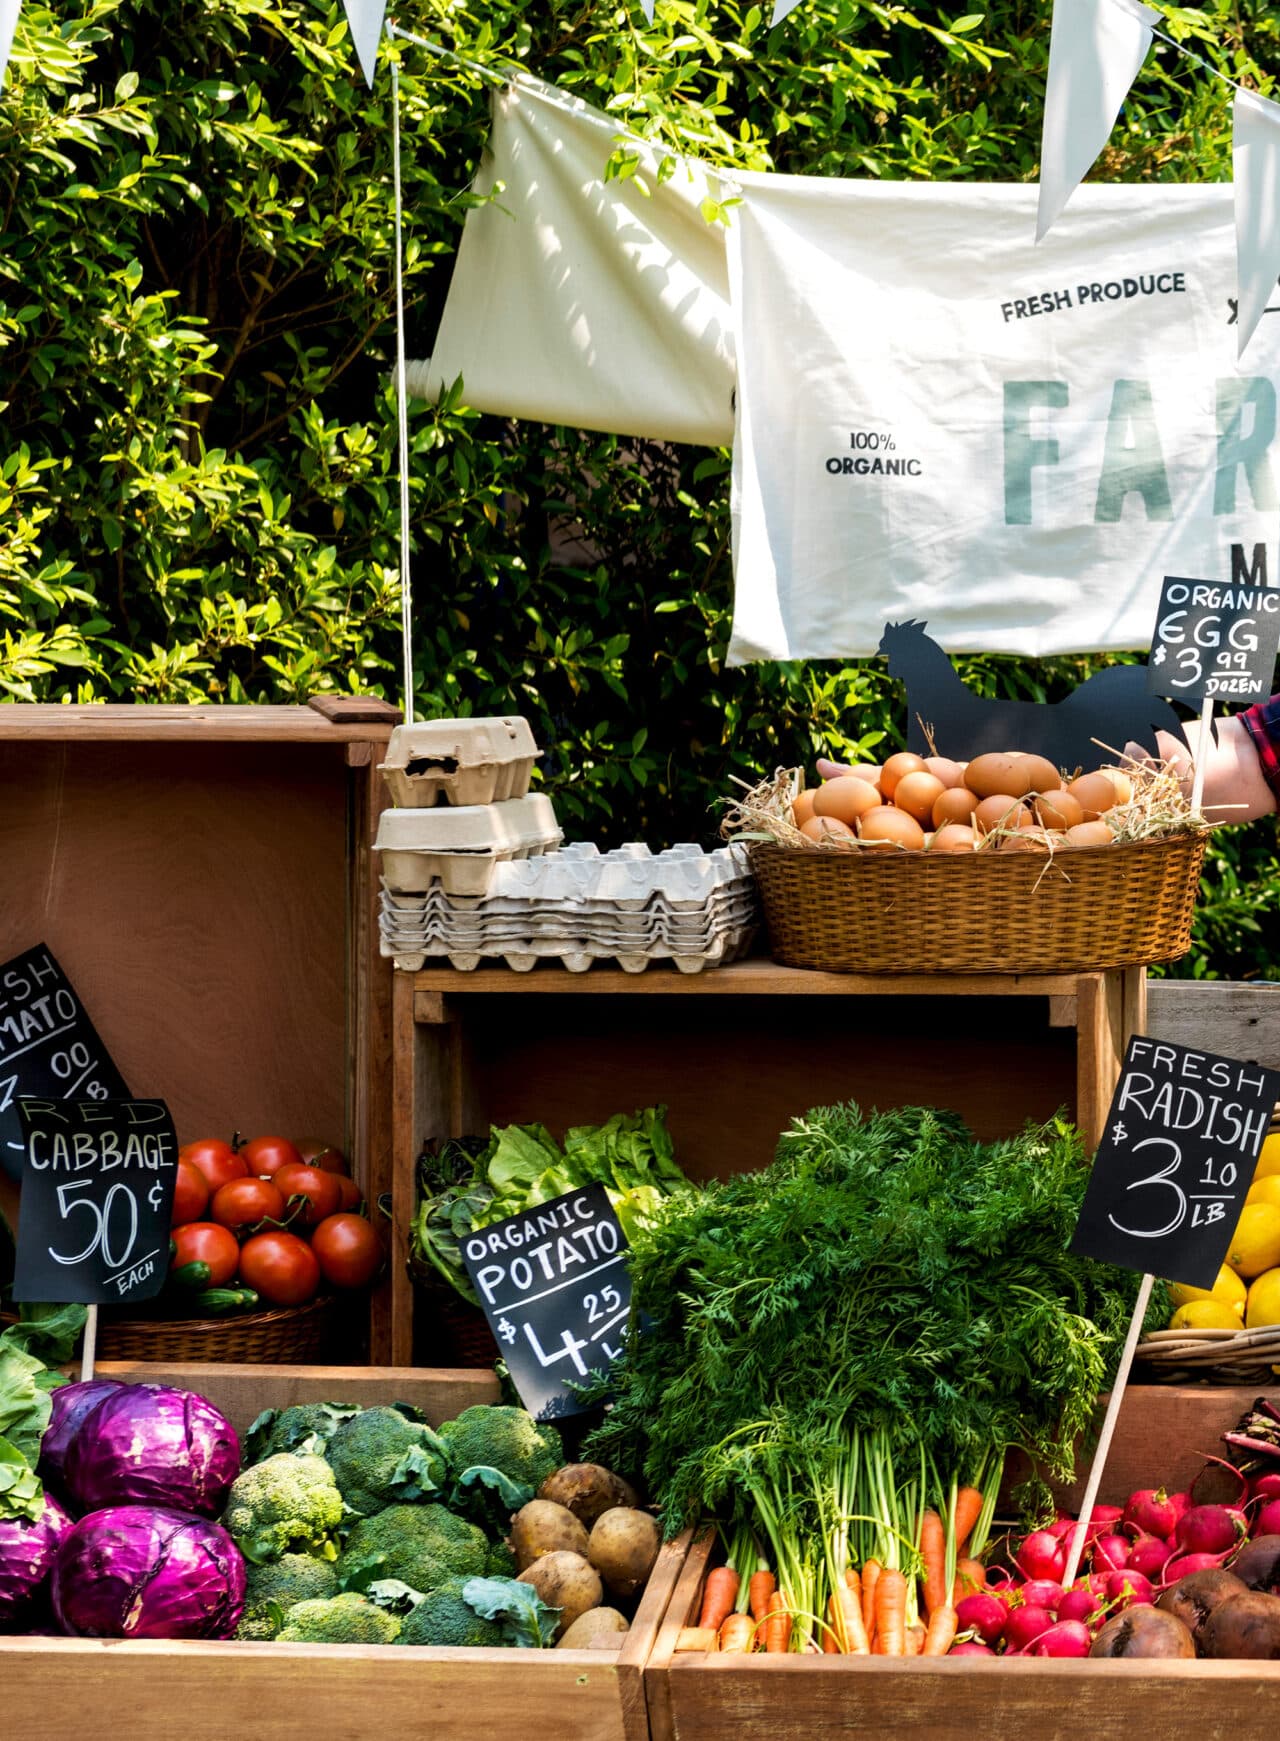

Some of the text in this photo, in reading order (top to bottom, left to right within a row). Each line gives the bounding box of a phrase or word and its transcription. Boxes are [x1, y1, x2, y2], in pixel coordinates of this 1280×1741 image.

[1001, 272, 1186, 323] FRESH PRODUCE
[849, 432, 896, 451] 100%
[826, 457, 922, 477] ORGANIC
[1166, 584, 1279, 613] ORGANIC
[1158, 610, 1259, 652] EGG
[1205, 677, 1263, 696] DOZEN
[1129, 1041, 1266, 1097] FRESH
[20, 1100, 166, 1124] RED
[1118, 1072, 1268, 1158] RADISH
[29, 1130, 174, 1172] CABBAGE
[466, 1197, 595, 1261] ORGANIC
[1190, 1202, 1226, 1229] LB
[116, 1260, 155, 1296] EACH
[476, 1220, 618, 1305] POTATO
